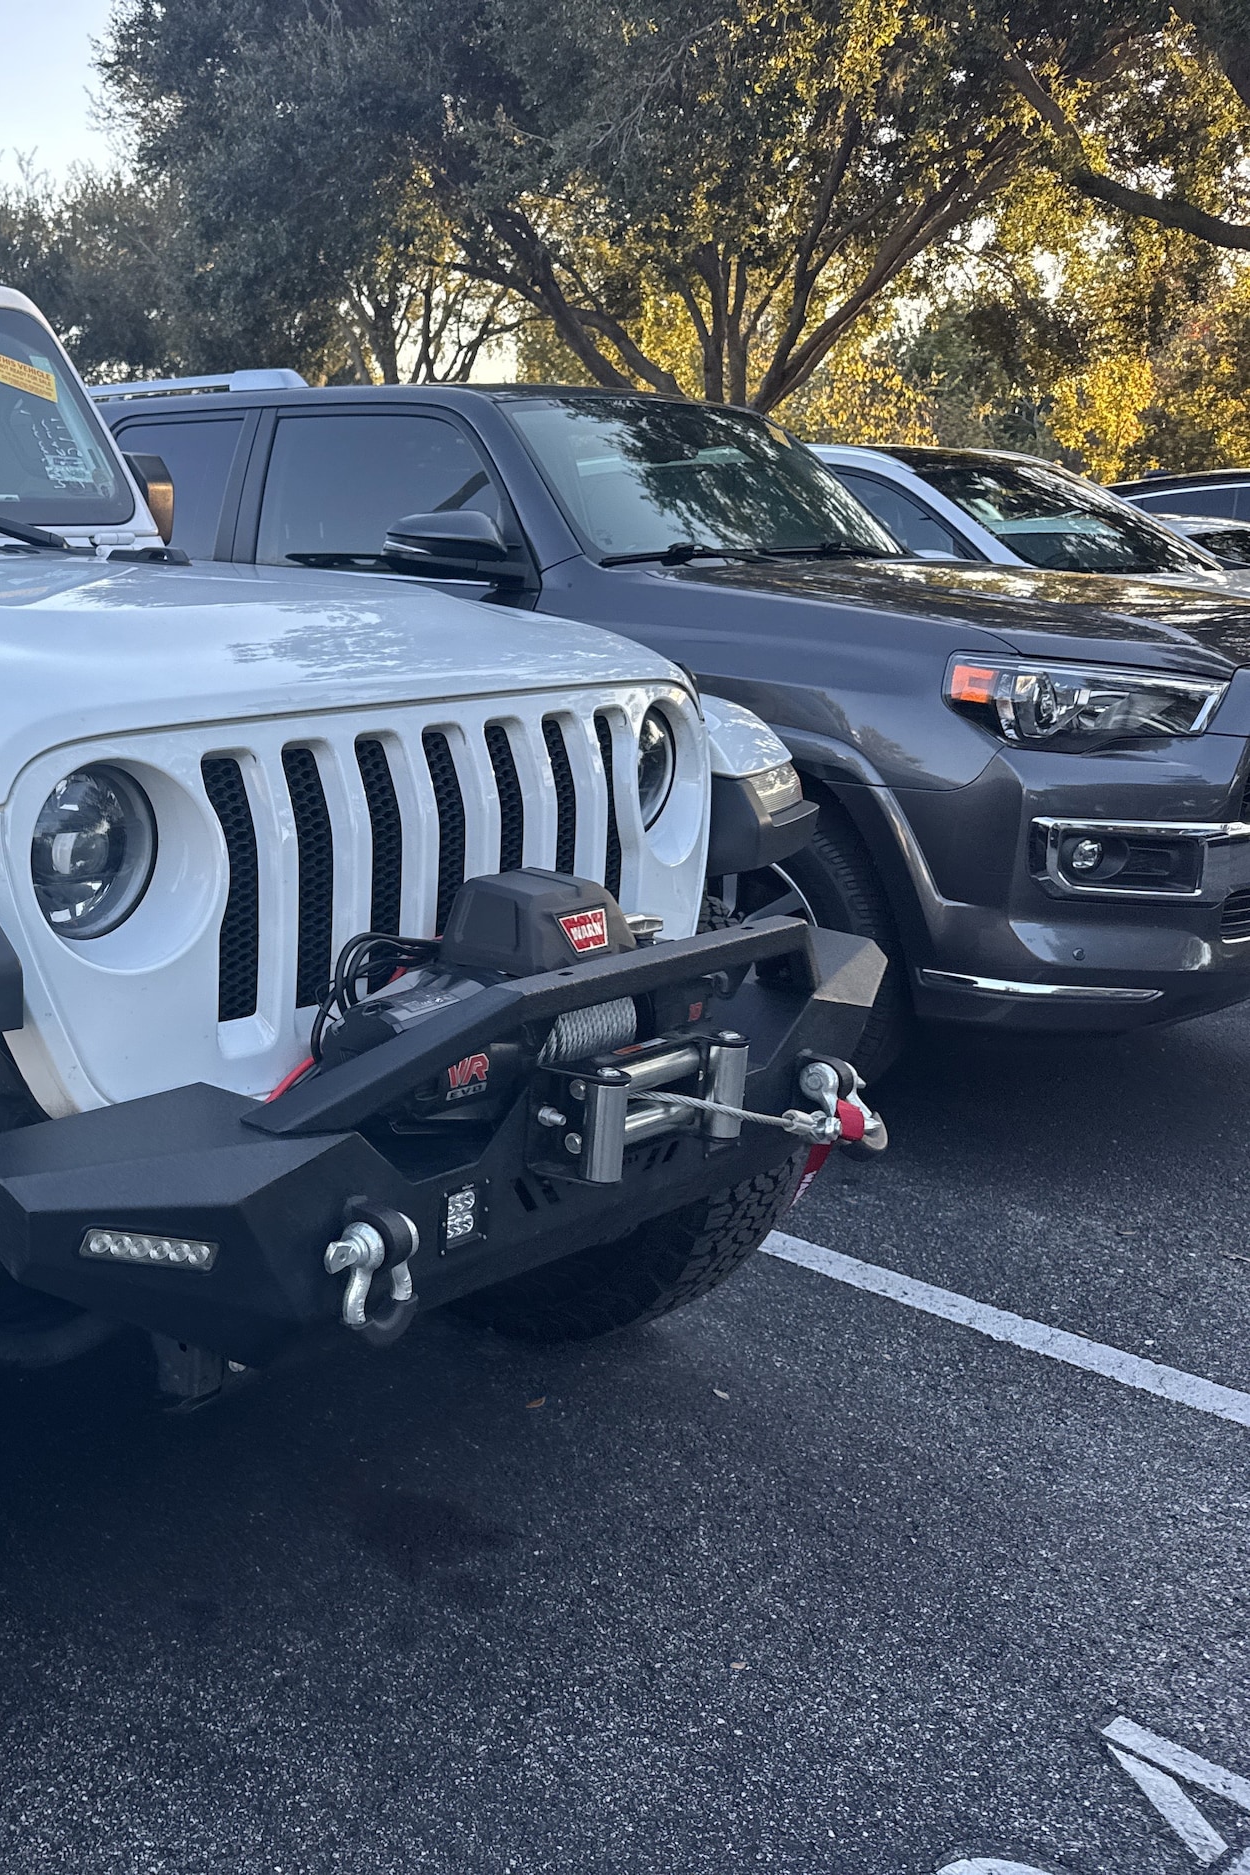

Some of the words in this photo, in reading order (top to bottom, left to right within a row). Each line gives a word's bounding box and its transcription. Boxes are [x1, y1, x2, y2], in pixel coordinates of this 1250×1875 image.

[17, 362, 52, 380] VEHICLE
[570, 921, 603, 940] WARN
[448, 1053, 489, 1088] VR
